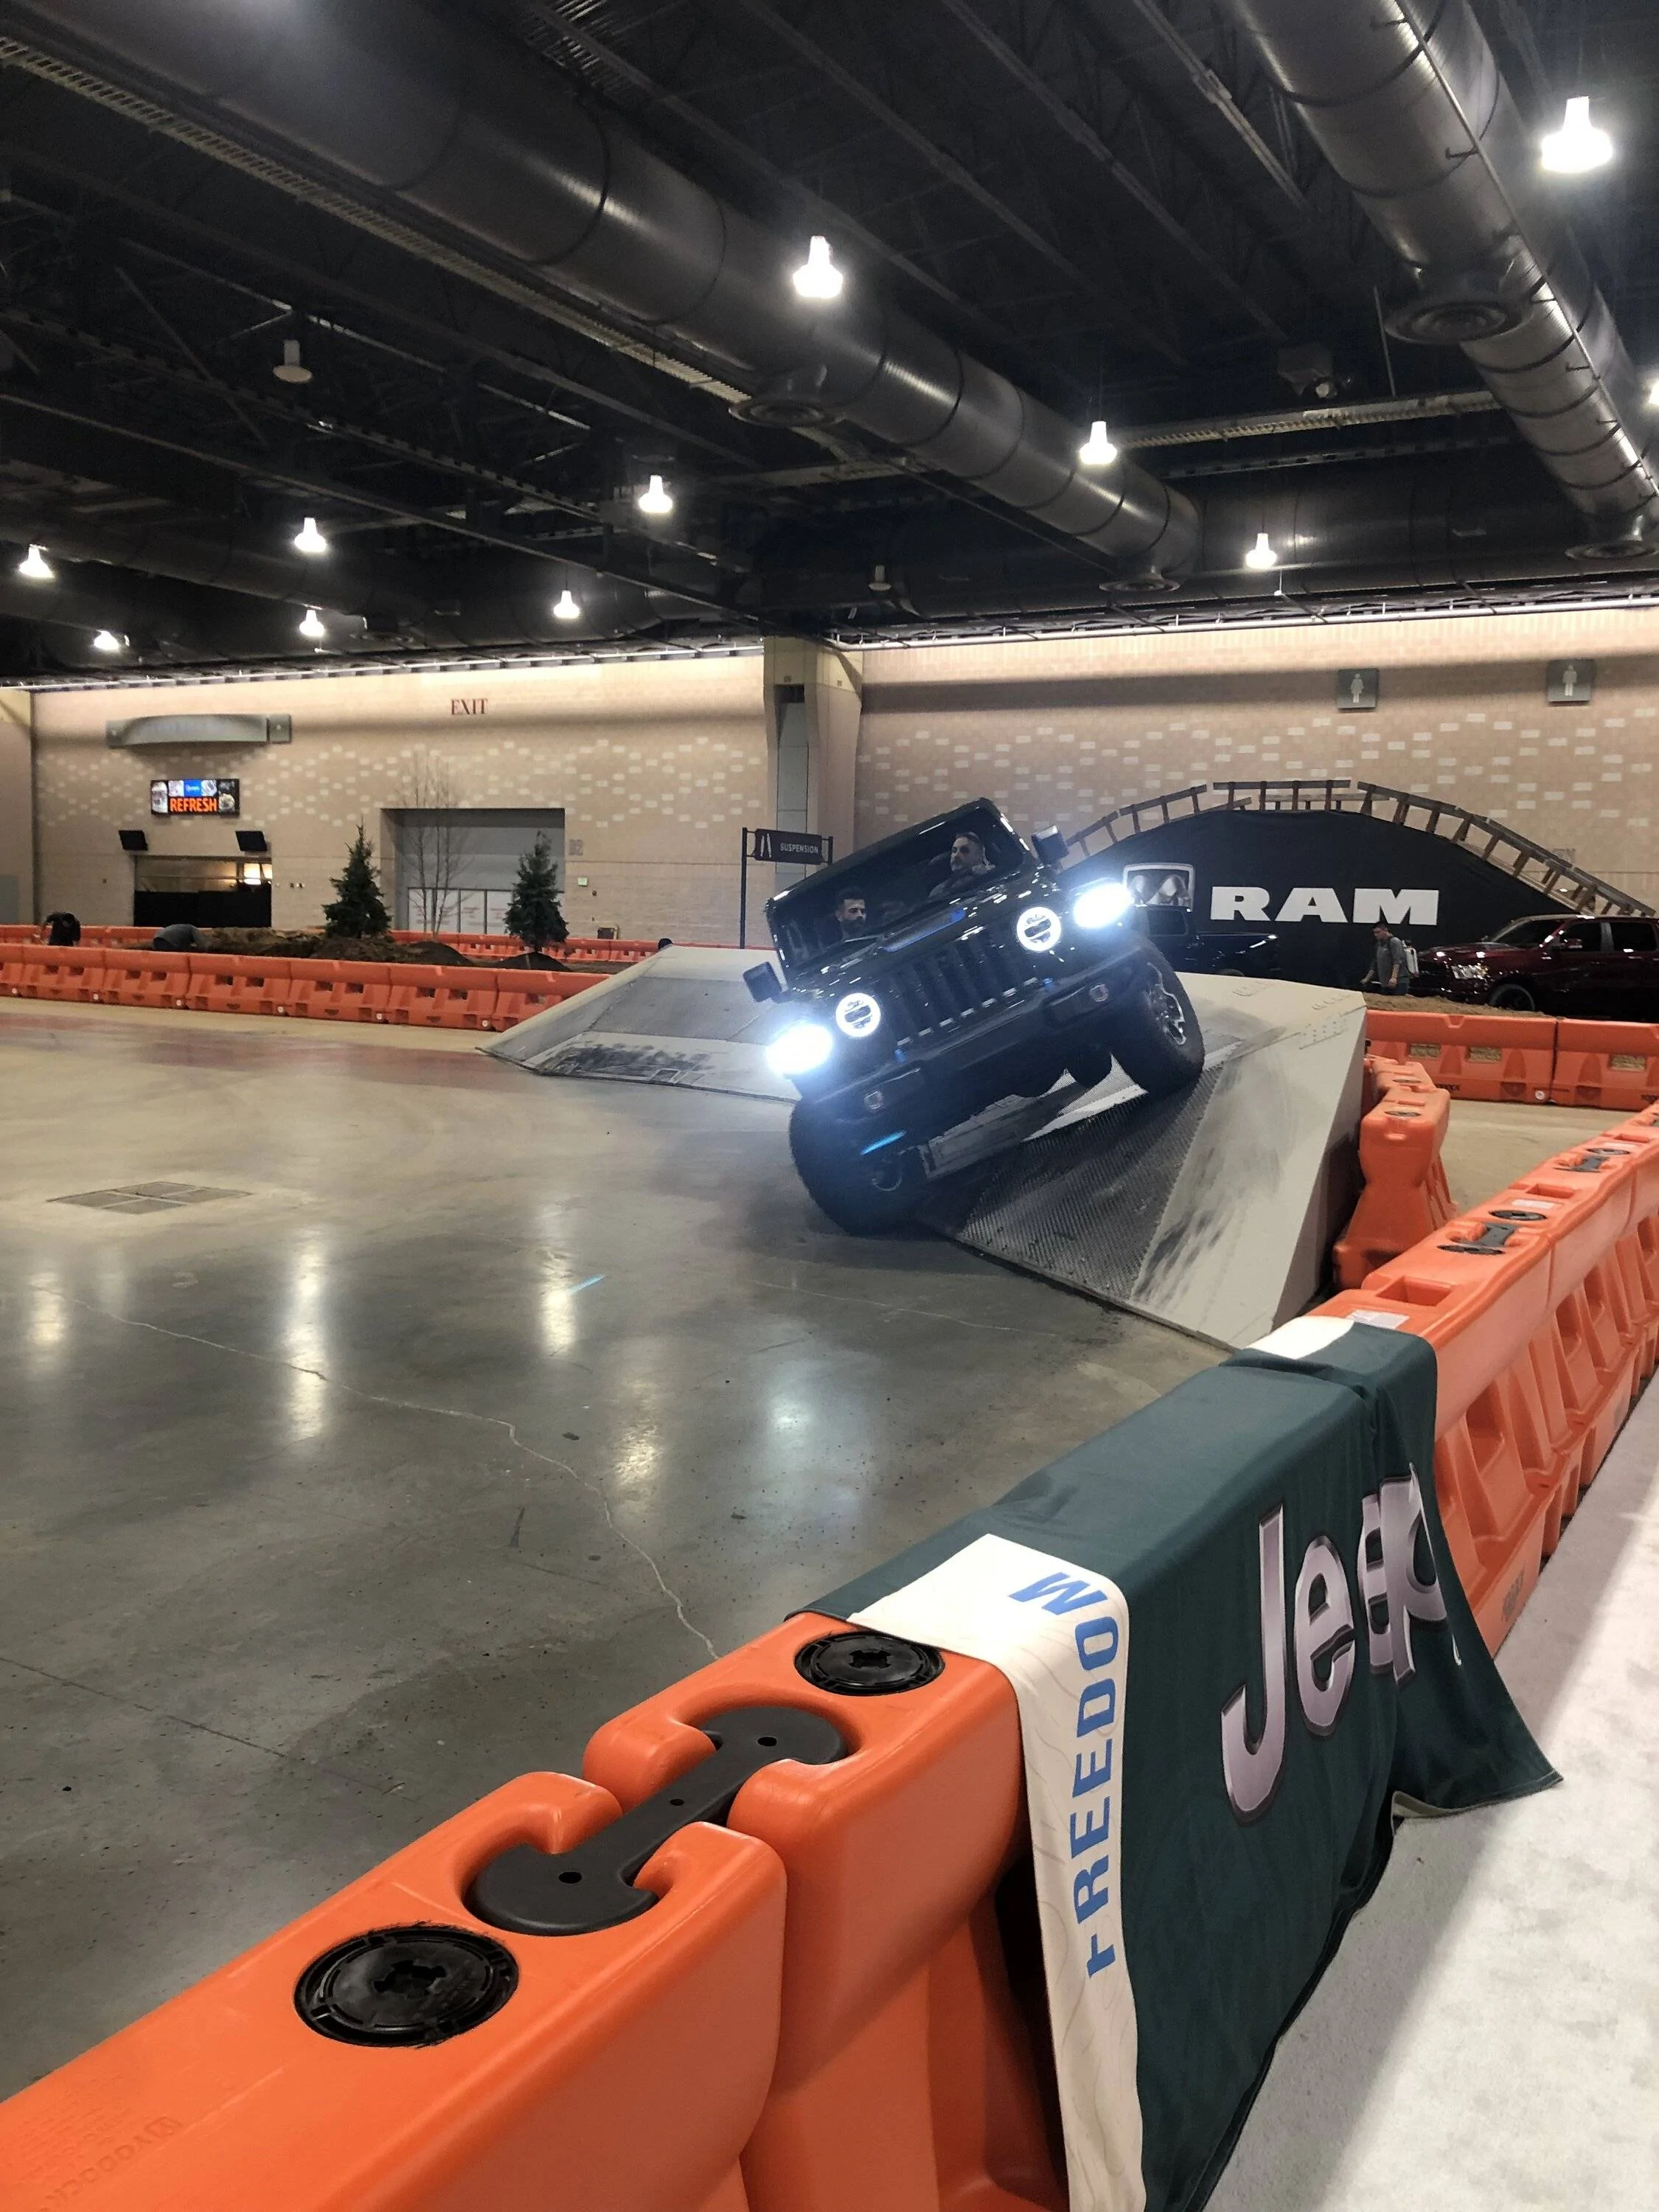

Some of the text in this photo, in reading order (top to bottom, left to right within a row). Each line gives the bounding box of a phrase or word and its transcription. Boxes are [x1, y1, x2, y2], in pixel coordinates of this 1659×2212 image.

[450, 698, 489, 715] EXIT
[170, 798, 218, 812] REFRESH
[780, 843, 818, 854] SUSPENSION
[1210, 886, 1439, 925] RAM
[1007, 1571, 1119, 1978] FREEDOM
